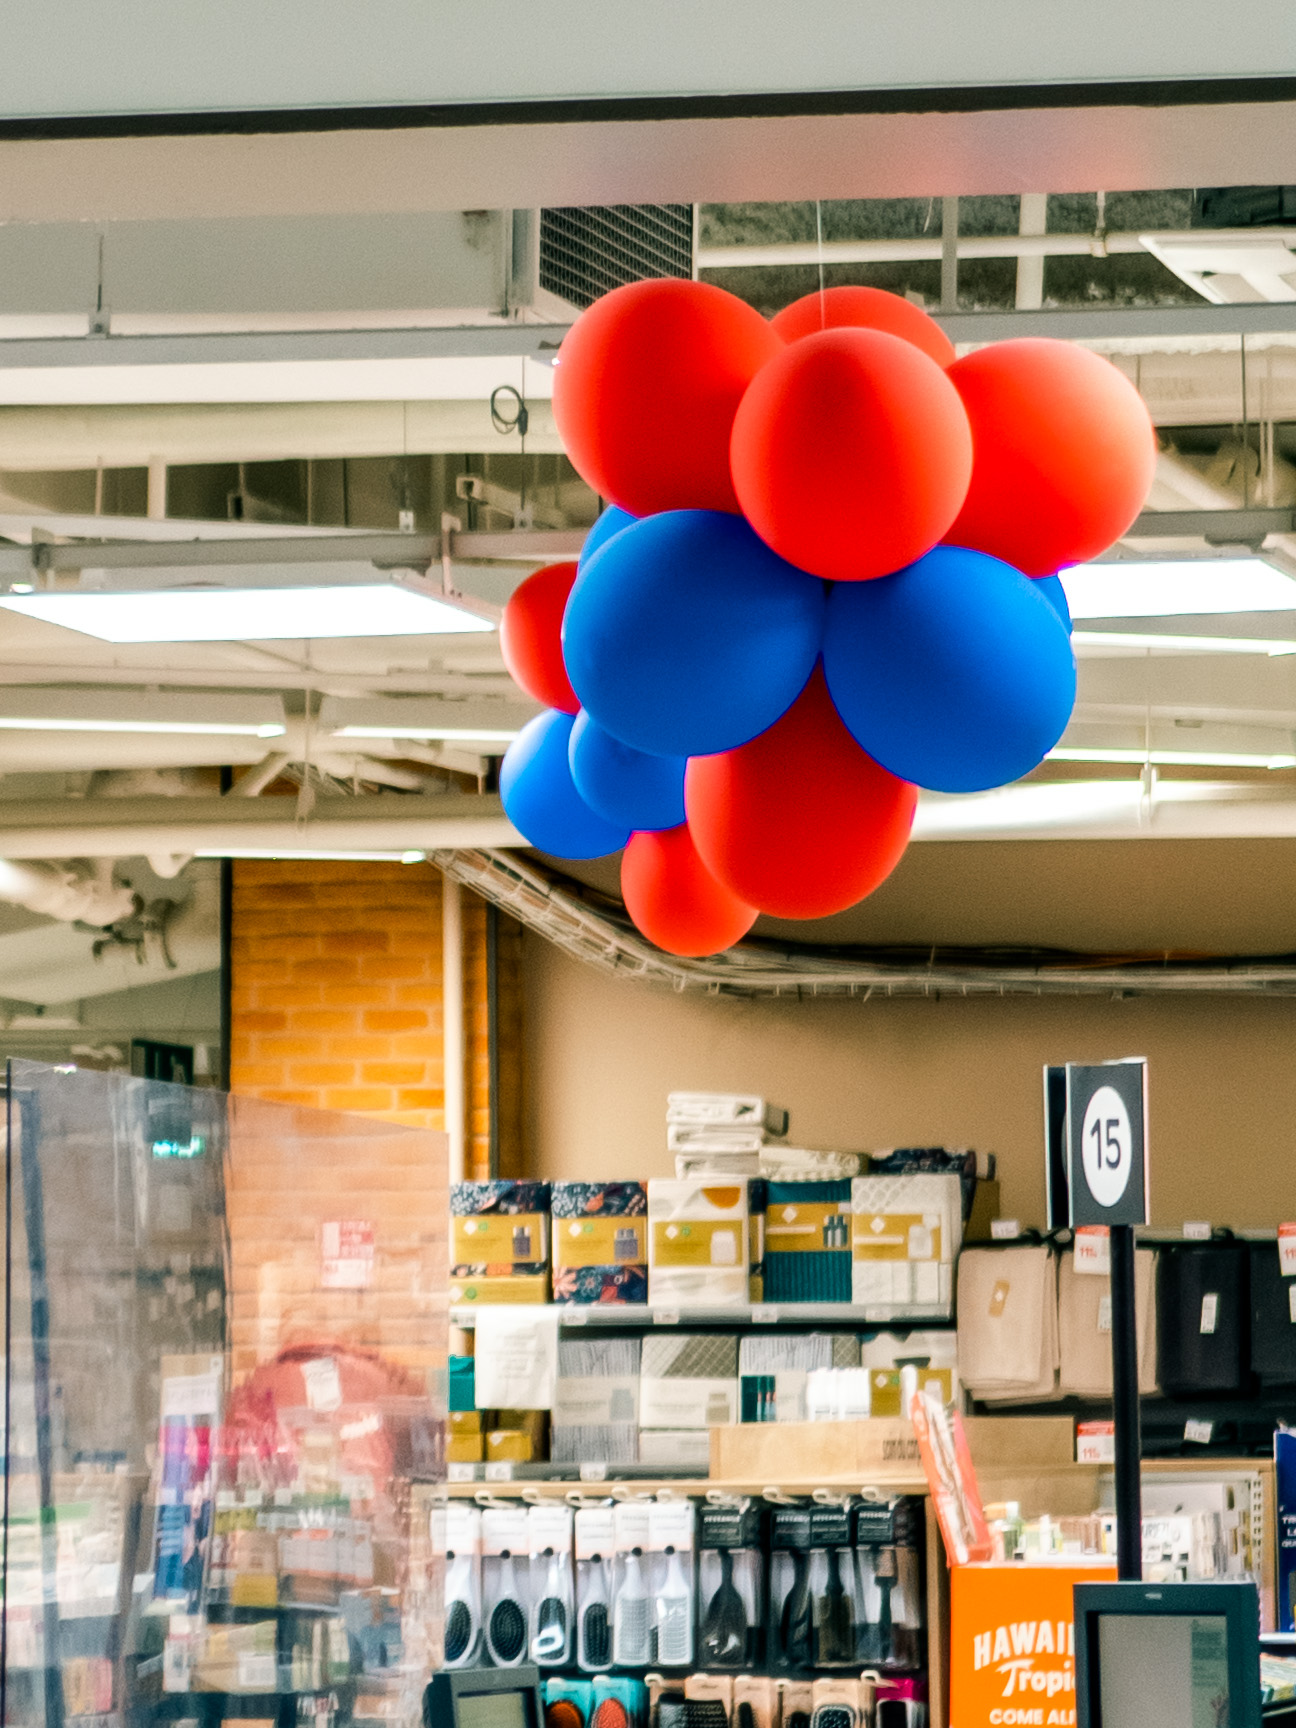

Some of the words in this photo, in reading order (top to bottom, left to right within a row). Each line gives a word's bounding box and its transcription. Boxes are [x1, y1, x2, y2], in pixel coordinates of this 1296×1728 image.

[1090, 1118, 1122, 1170] 15
[996, 1658, 1075, 1698] Tropi
[989, 1708, 1043, 1725] COME
